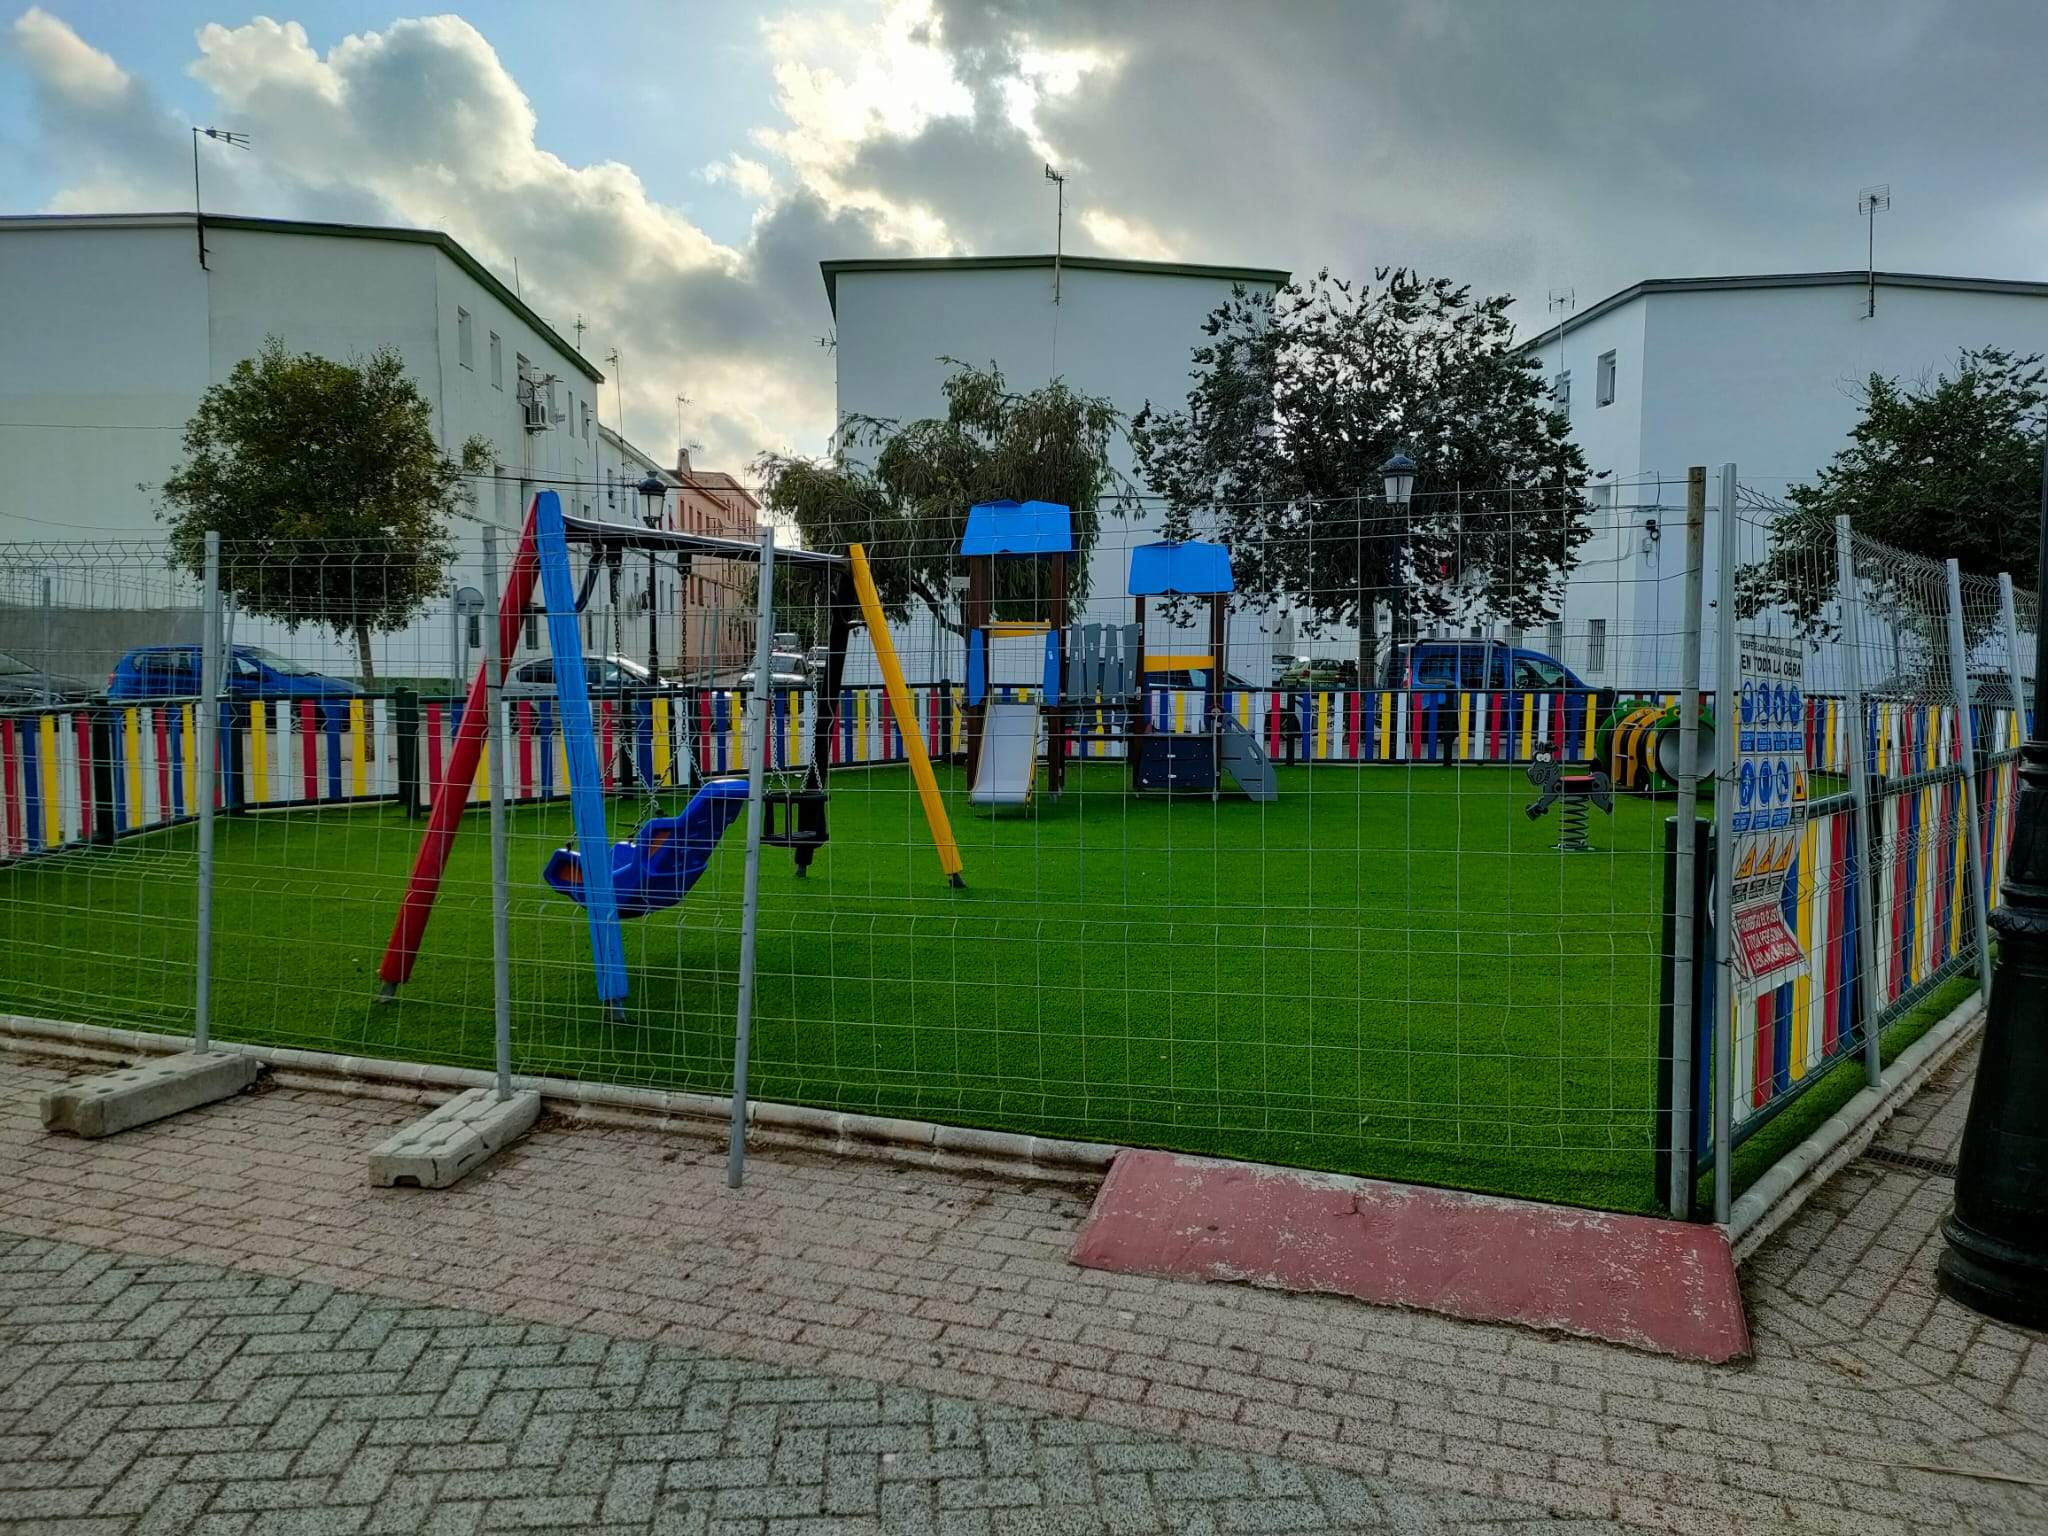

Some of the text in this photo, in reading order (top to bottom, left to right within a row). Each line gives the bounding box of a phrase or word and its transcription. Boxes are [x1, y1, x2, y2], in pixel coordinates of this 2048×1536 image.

[1741, 654, 1801, 678] EN TODA LA OBRA
